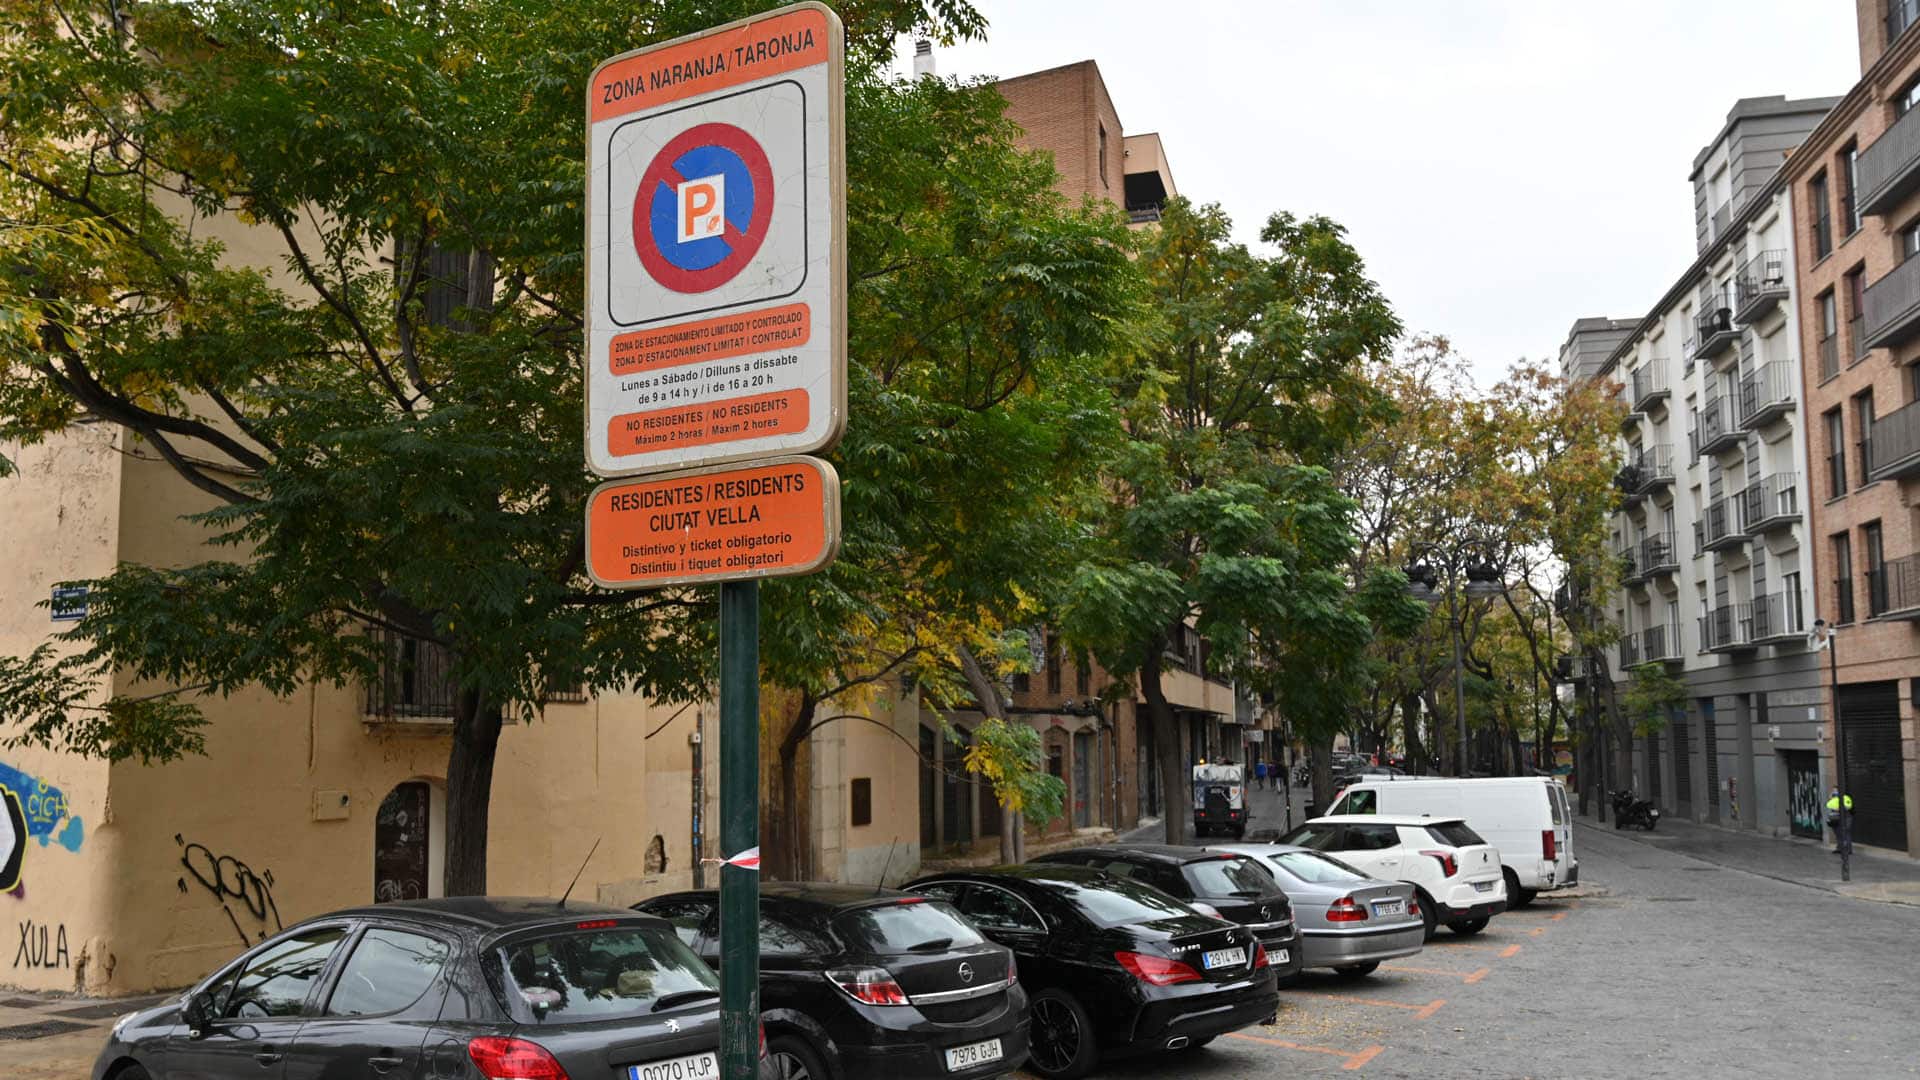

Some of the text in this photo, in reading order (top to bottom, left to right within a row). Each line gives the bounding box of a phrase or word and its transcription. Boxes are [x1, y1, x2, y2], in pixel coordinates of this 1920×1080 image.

[604, 76, 645, 104] ZONA
[684, 183, 716, 237] P
[615, 312, 802, 353] ZONA DE ESTACIONAMIENTO LIMITADO Y CONTROLADO
[615, 356, 636, 367] ZONA
[714, 337, 744, 352] LIMITAT
[752, 328, 802, 344] CONTROLAT
[621, 378, 650, 392] Lunes
[653, 379, 659, 387] a
[662, 370, 698, 385] Sábado
[706, 364, 741, 378] Dilluns
[744, 363, 750, 372] a
[754, 354, 798, 370] dissabte
[638, 392, 650, 404] de
[652, 392, 657, 401] 9
[670, 388, 680, 398] 14
[684, 387, 689, 397] h
[692, 388, 698, 398] y
[713, 381, 724, 393] de
[729, 379, 739, 390] 16
[743, 380, 748, 388] a
[752, 376, 763, 386] 20
[767, 374, 773, 384] h
[627, 420, 640, 431] NO
[643, 411, 703, 429] RESIDENTES
[713, 408, 727, 418] NO
[730, 398, 788, 416] RESIDENTS
[671, 431, 675, 440] 2
[678, 428, 703, 440] horas
[744, 421, 749, 431] 2
[752, 417, 778, 429] hores
[611, 485, 703, 512] RESIDENTES
[714, 474, 805, 500] RESIDENTS
[650, 505, 761, 532] CIUTAT VELLA
[623, 532, 792, 558] Distintivo y ticket obligatorio
[630, 551, 784, 575] Distintiu i tiquet obligatori
[14, 919, 69, 968] XULA
[643, 1056, 712, 1080] 0070 HJP
[952, 1041, 998, 1065] 7978 GJH
